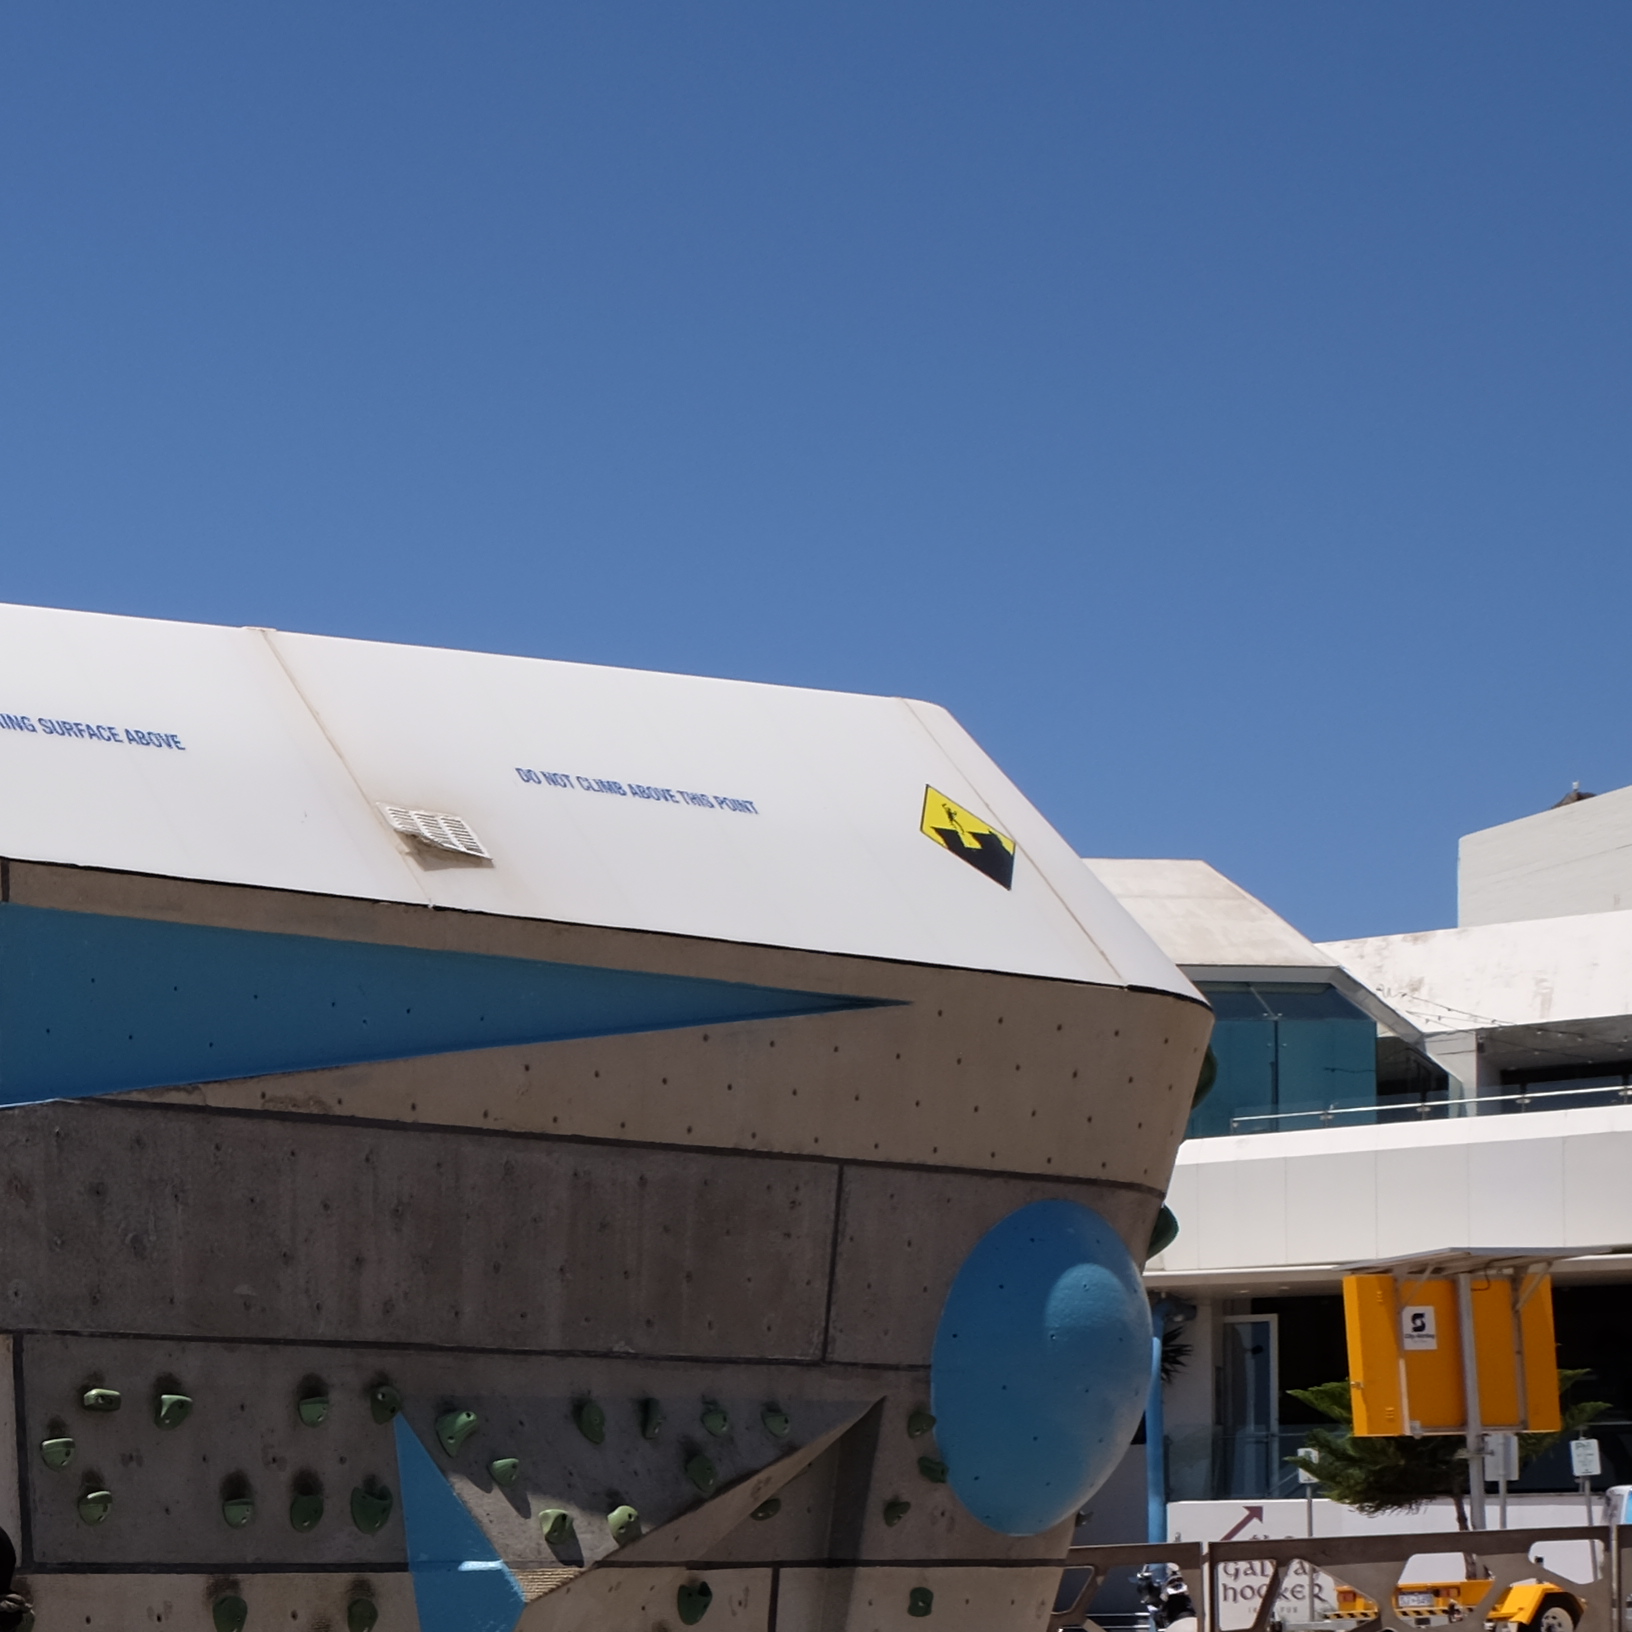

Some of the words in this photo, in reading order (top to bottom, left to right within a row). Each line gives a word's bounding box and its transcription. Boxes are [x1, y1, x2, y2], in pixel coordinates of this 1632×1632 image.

[37, 718, 124, 744] SURFACE
[124, 728, 186, 751] ABOVE
[515, 767, 543, 784] DO
[541, 771, 575, 790] NOT
[576, 775, 628, 796] CLIMB
[627, 783, 678, 804] ABOVE
[676, 790, 715, 809] THIS
[712, 795, 760, 815] POINT
